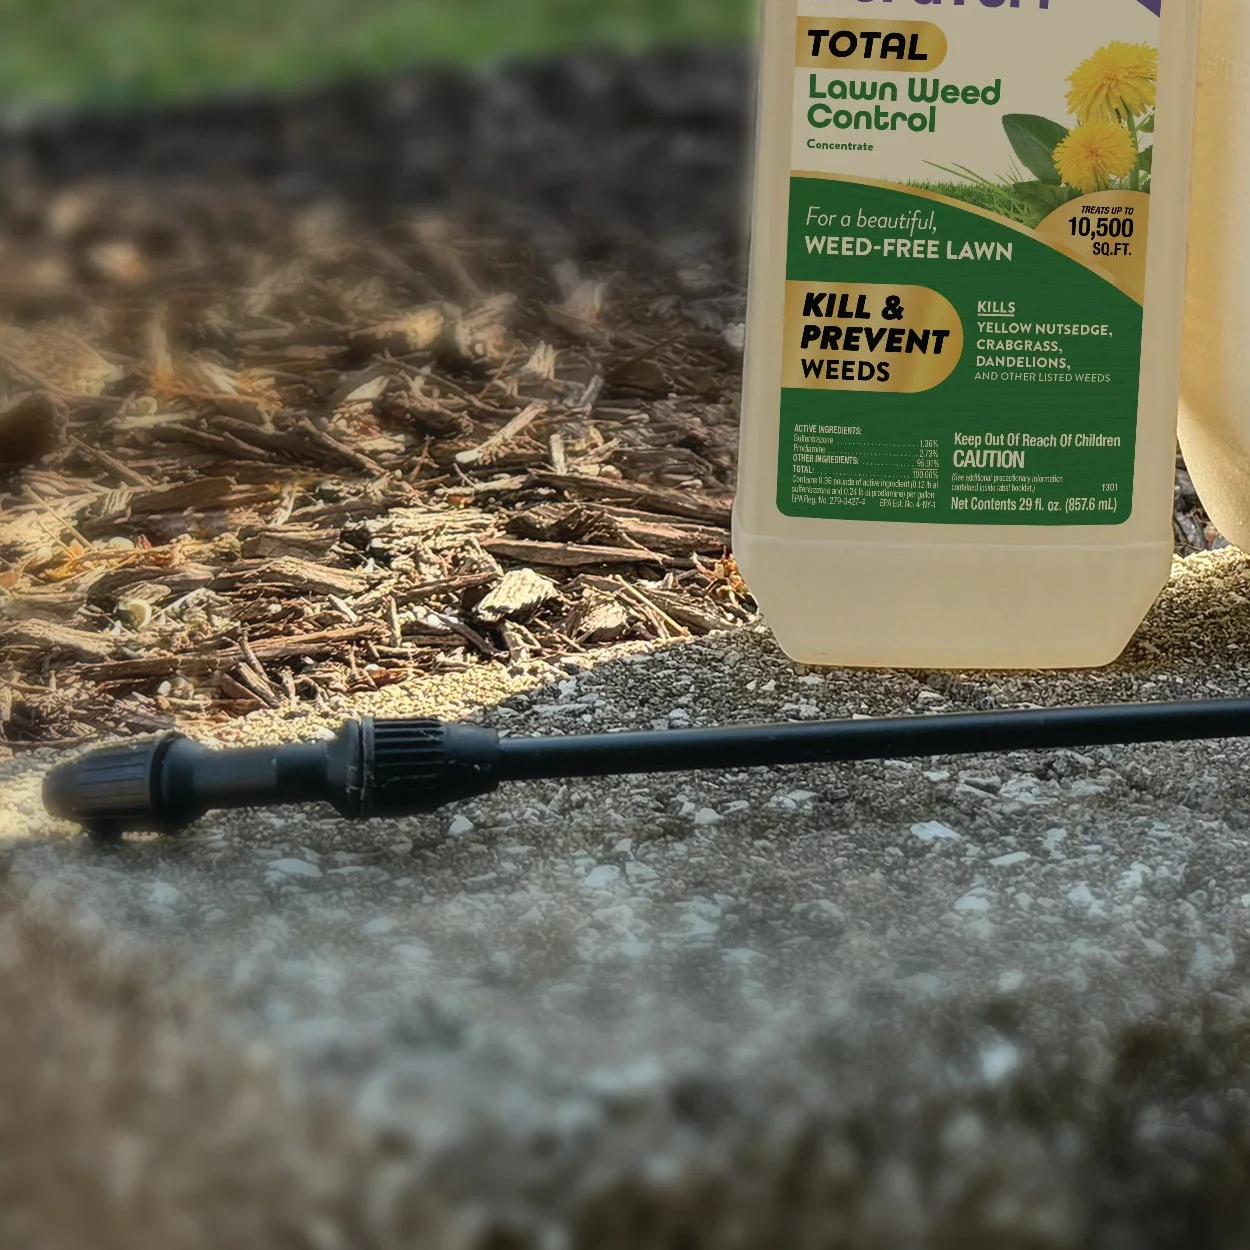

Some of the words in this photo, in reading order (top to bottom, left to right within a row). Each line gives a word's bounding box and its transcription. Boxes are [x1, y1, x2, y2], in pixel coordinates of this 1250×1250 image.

[808, 29, 928, 61] TOTAL
[809, 74, 898, 102] Lawn
[907, 78, 1001, 106] Weed
[807, 103, 936, 133] Control
[806, 138, 874, 152] Concentrate
[1081, 205, 1109, 214] TREATS
[1111, 206, 1122, 215] UP
[1123, 206, 1134, 215] TO
[806, 206, 837, 229] For
[841, 215, 851, 229] a
[856, 209, 938, 236] beautiful,
[1068, 216, 1134, 241] 10,500
[804, 235, 940, 259] WEED-FREE
[946, 240, 1013, 261] LAWN
[1092, 241, 1132, 257] SQ.FT.
[802, 291, 871, 320] KILL
[881, 295, 905, 321] &
[977, 300, 1016, 315] KILLS
[977, 321, 1032, 334] YELLOW
[1035, 322, 1113, 338] NUTSEDGE,
[800, 324, 950, 355] PREVENT
[976, 338, 1063, 354] CRABGRASS,
[801, 358, 890, 382] WEEDS
[976, 355, 1071, 370] DANDELIONS,
[974, 371, 998, 381] AND
[1000, 371, 1036, 382] OTHER
[1038, 372, 1072, 383] LISTED
[1074, 373, 1111, 383] WEEDS
[794, 424, 817, 433] ACTIVE
[818, 425, 862, 435] INGREDIENTS:
[954, 432, 982, 448] Keep
[985, 432, 1004, 446] Out
[1007, 432, 1020, 446] Of
[1022, 433, 1057, 447] Reach
[1060, 433, 1073, 447] Of
[1074, 433, 1121, 447] Children
[792, 454, 814, 463] OTHER
[953, 450, 1025, 468] CAUTION
[1101, 483, 1118, 492] 1301
[950, 496, 969, 510] Net
[970, 496, 1017, 510] Contents
[1018, 497, 1032, 511] 29
[1034, 497, 1044, 511] fl.
[1047, 500, 1062, 512] oz.
[1065, 497, 1095, 513] (857.6
[1098, 497, 1117, 513] mL)
